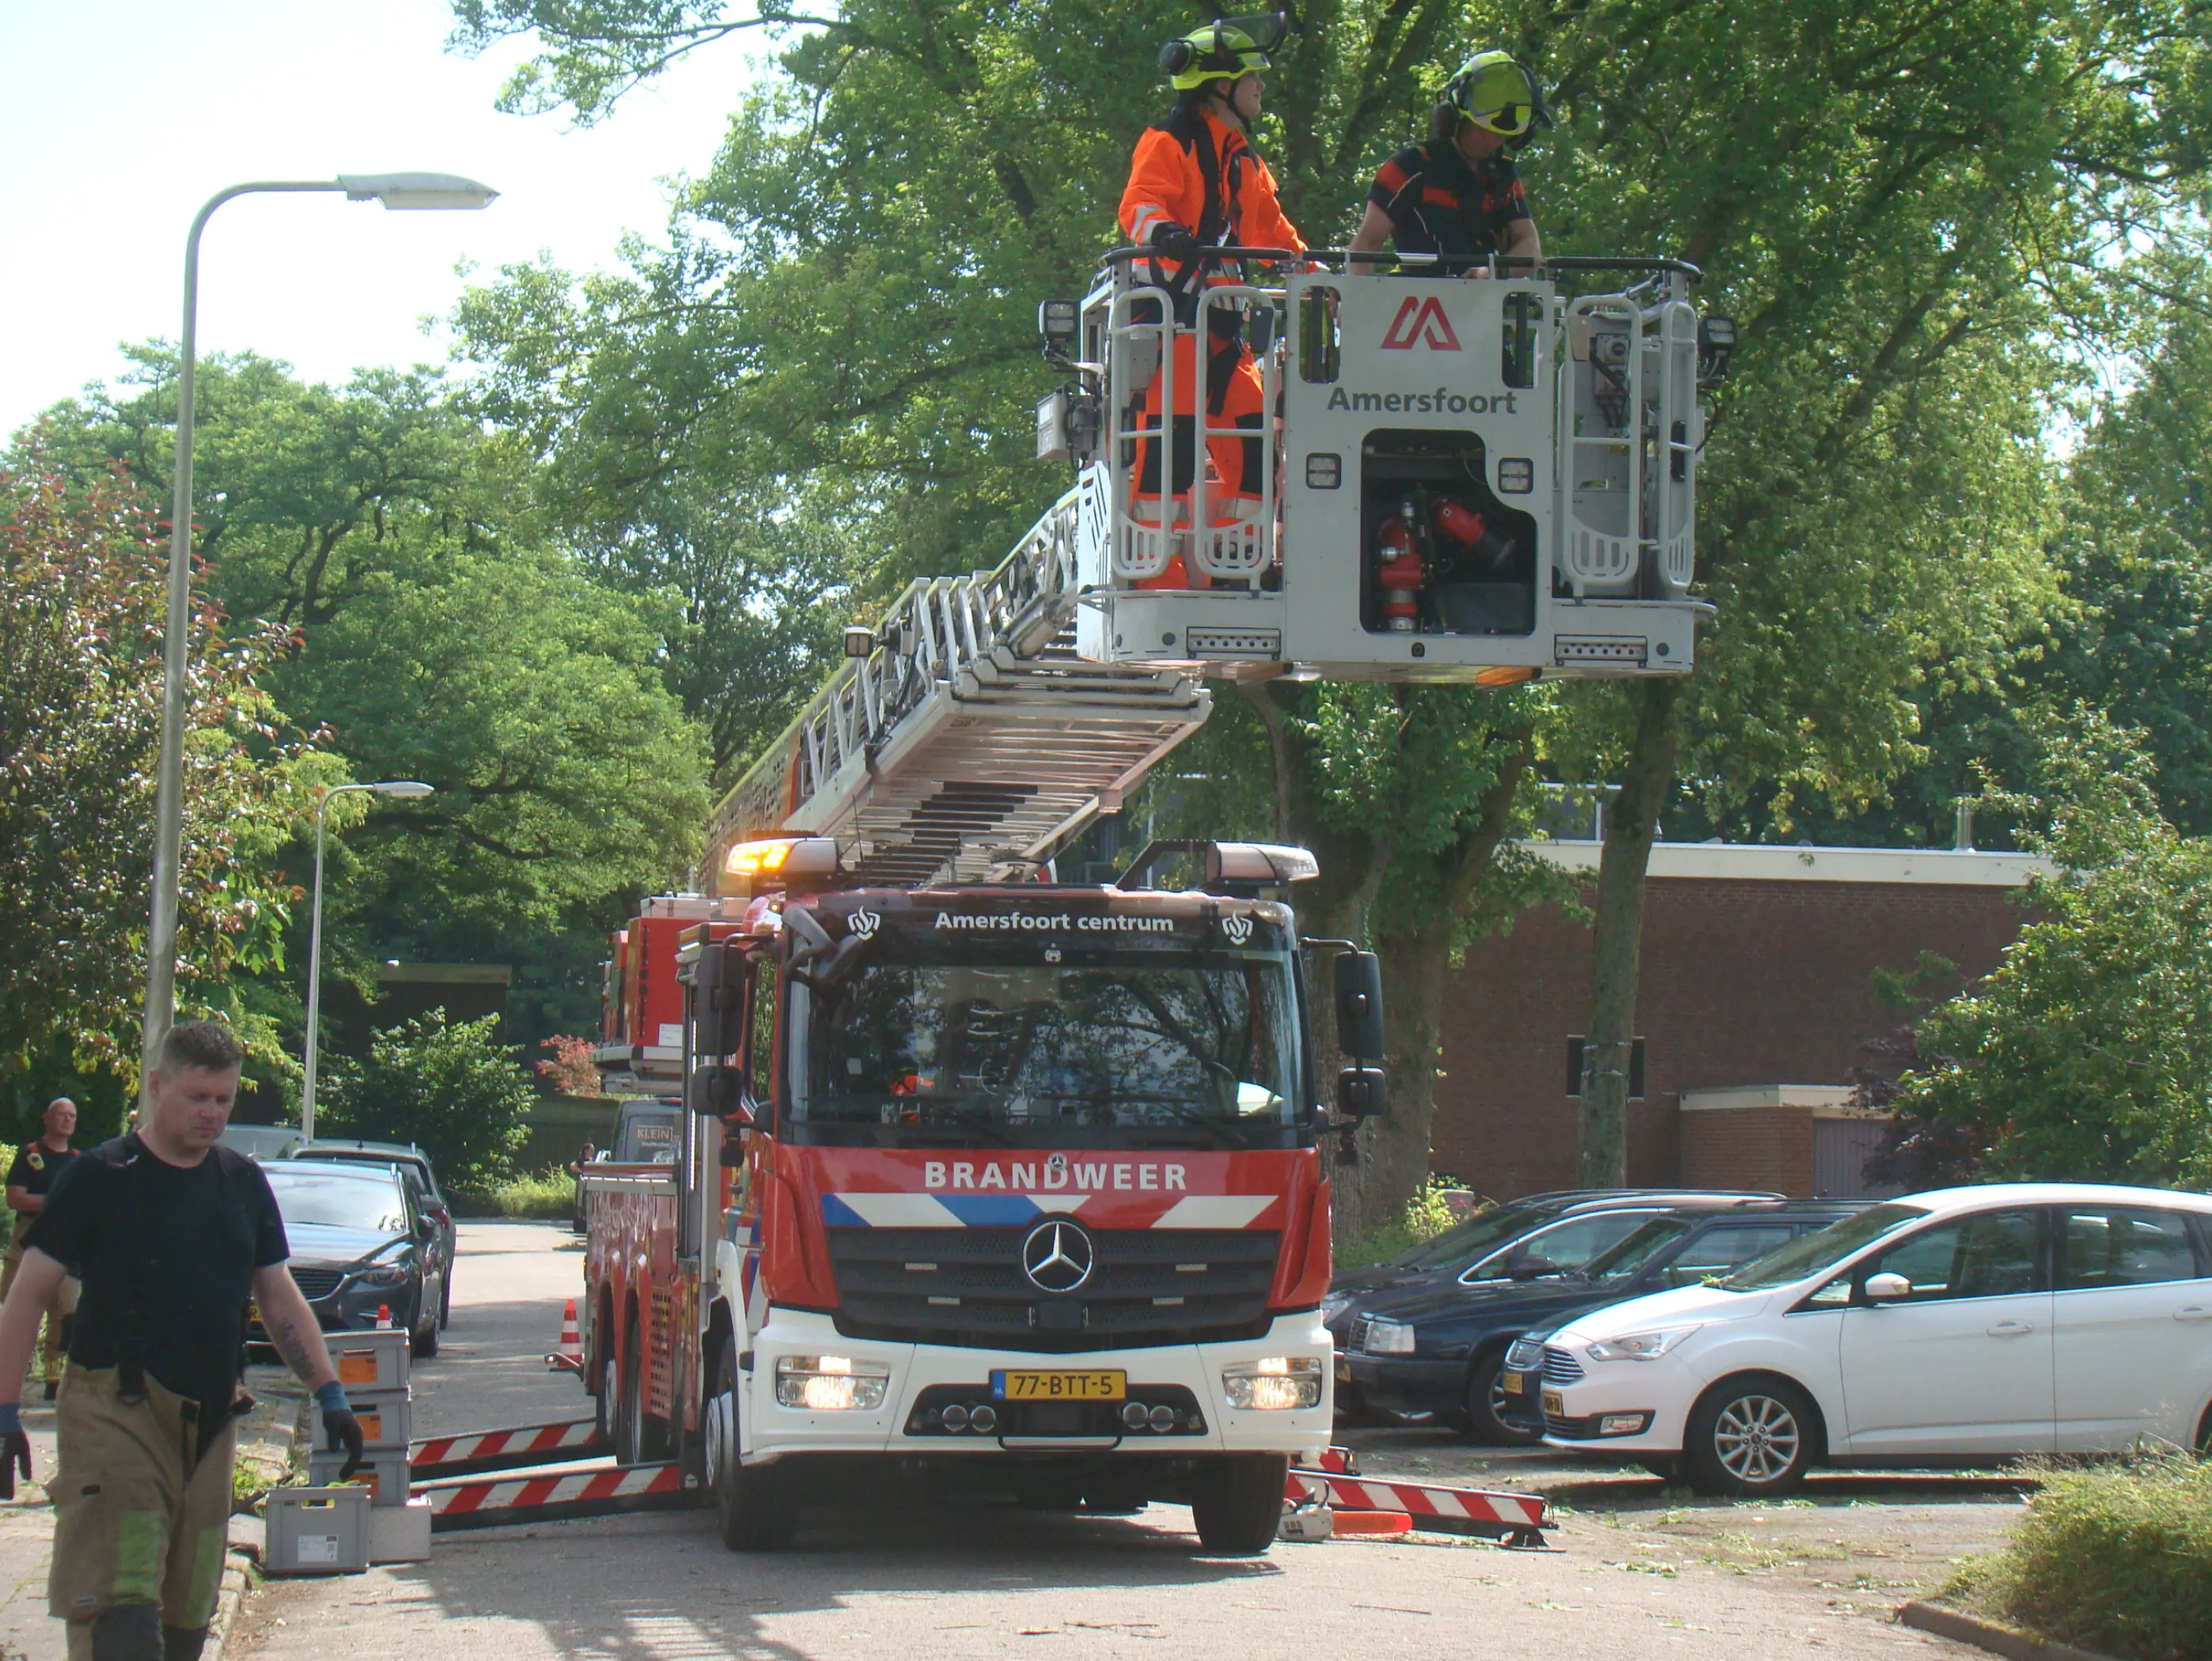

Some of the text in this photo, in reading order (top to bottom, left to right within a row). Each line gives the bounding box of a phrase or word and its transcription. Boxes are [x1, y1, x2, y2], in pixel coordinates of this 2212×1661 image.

[1327, 386, 1517, 415] Amersfoort
[934, 911, 1174, 931] Amersfoort centrum
[636, 1128, 670, 1139] KLEIN
[924, 1160, 1187, 1190] BRANDWEER
[1013, 1375, 1113, 1395] 77-BTT-5
